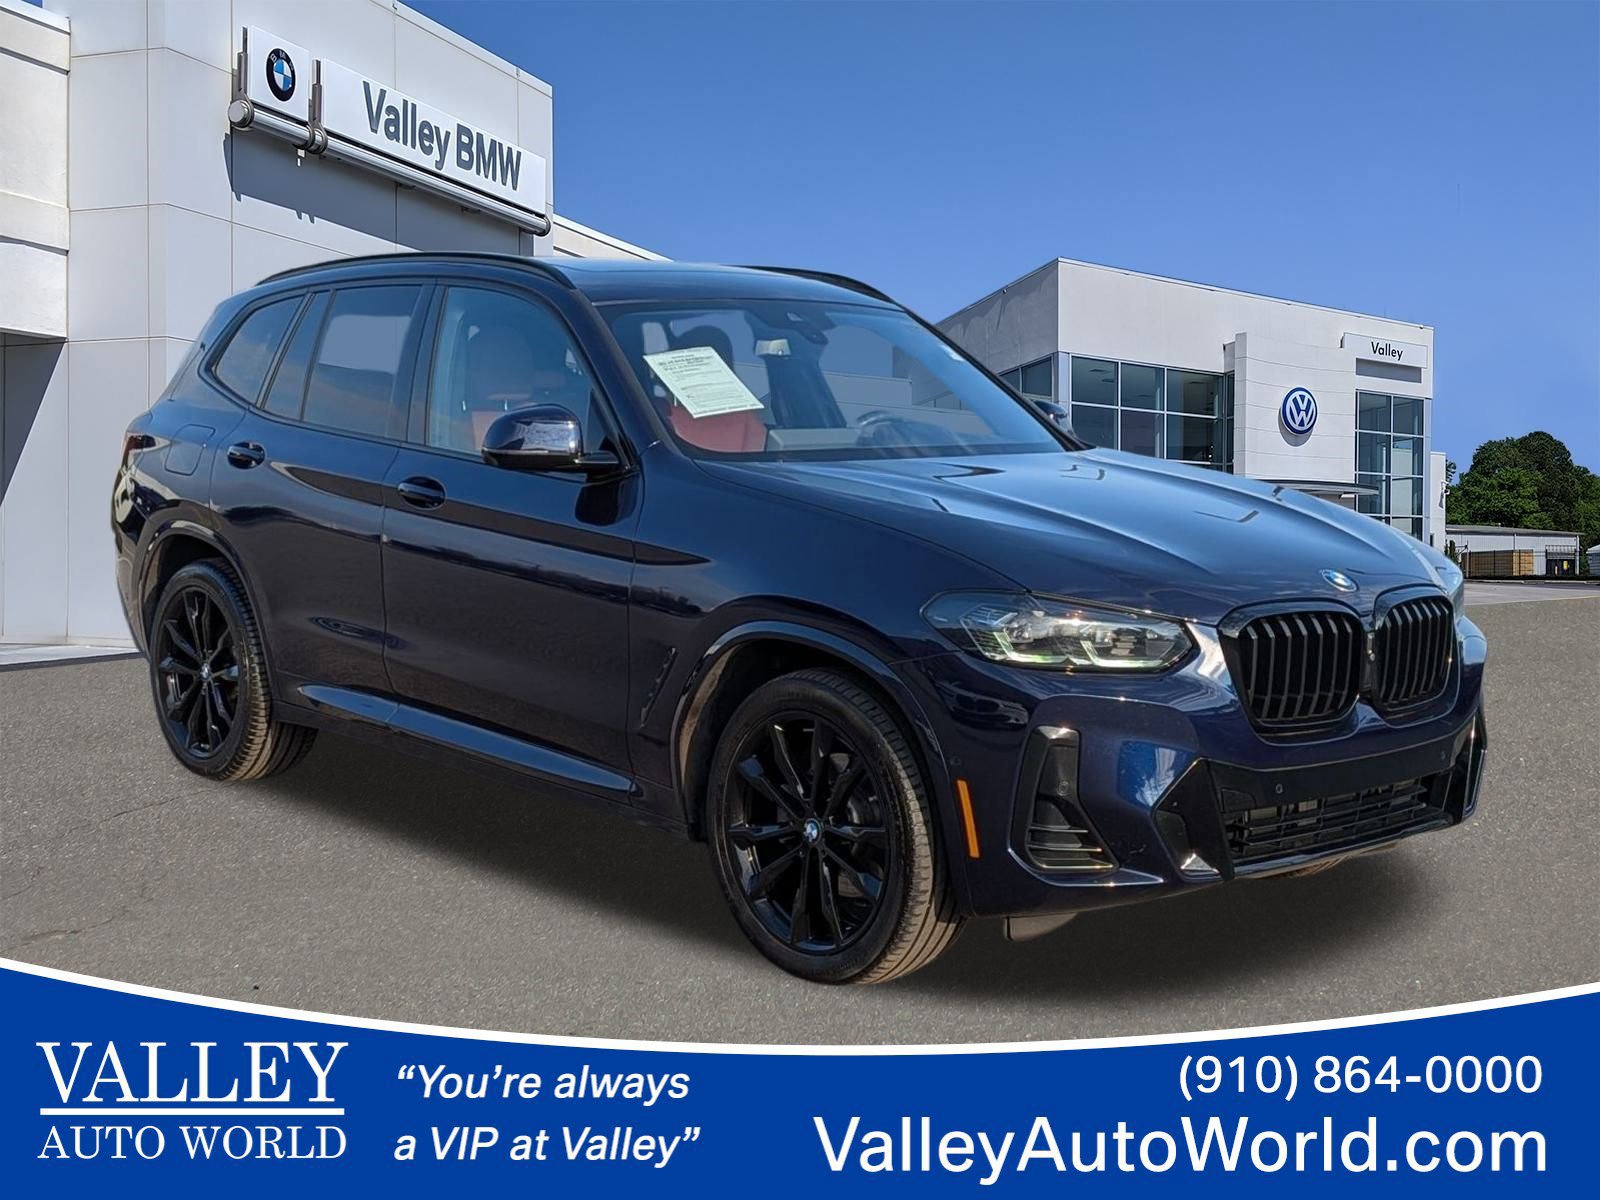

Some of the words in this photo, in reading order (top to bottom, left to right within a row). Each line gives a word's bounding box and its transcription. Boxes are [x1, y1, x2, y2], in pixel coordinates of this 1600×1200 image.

[362, 80, 451, 171] Valley
[456, 123, 522, 191] BMW
[1371, 341, 1403, 361] Valley
